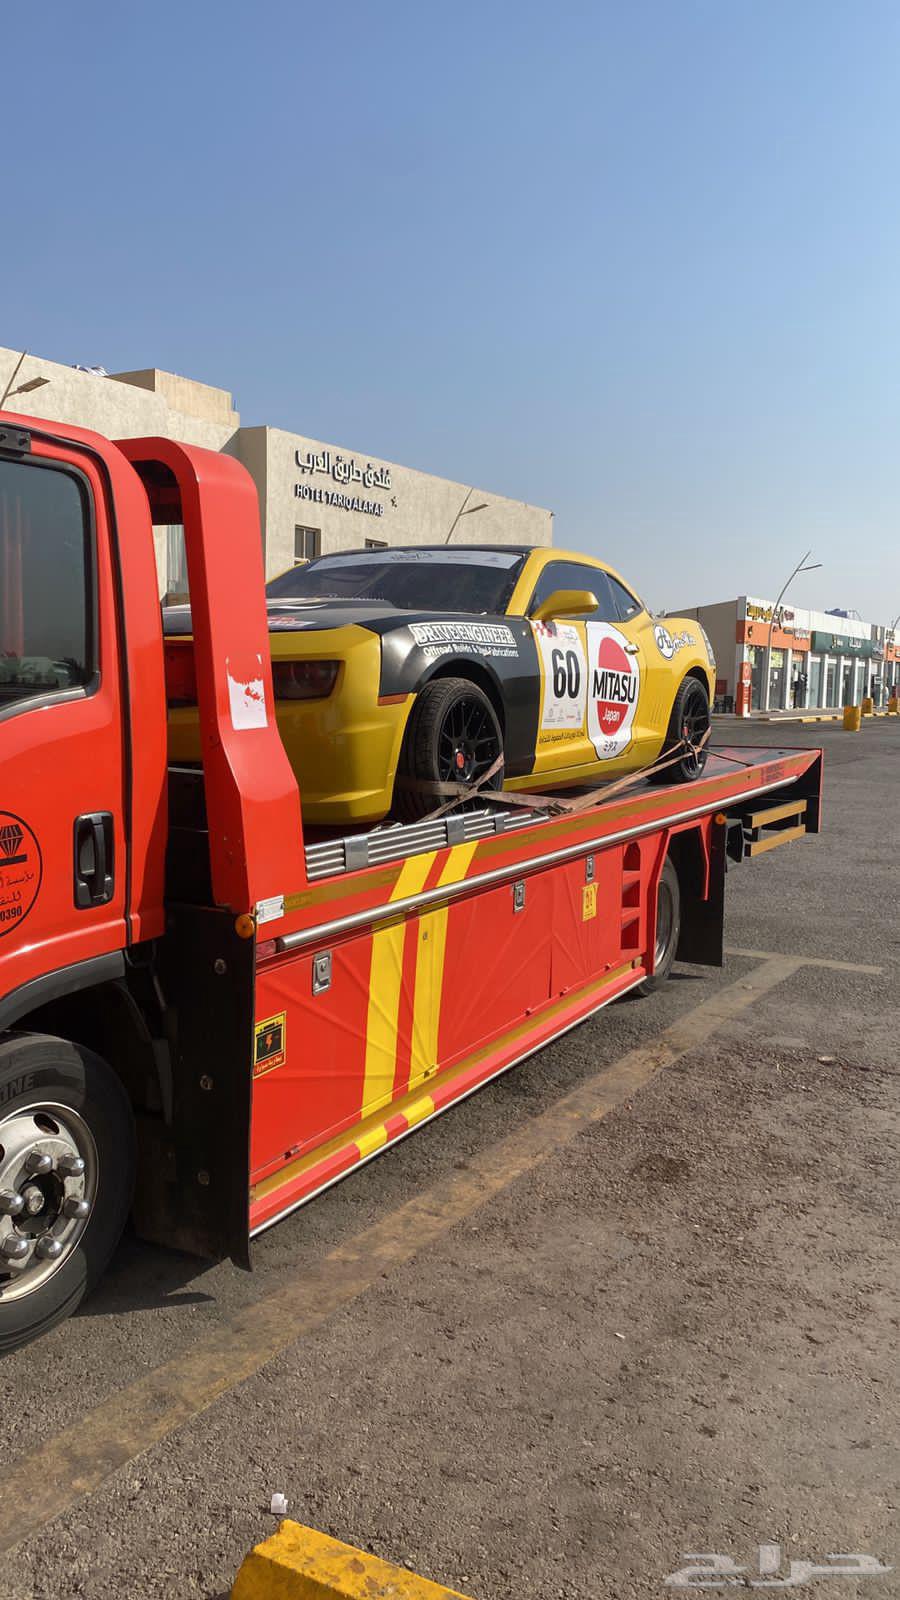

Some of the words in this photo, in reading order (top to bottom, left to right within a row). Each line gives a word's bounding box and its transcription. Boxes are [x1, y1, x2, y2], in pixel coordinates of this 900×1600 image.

[295, 447, 332, 474] العرب
[332, 455, 363, 484] طريق
[363, 462, 392, 489] فندق
[295, 483, 323, 503] HOTEL
[551, 648, 580, 699] 60
[592, 669, 637, 704] MITASU
[603, 707, 620, 724] Japan
